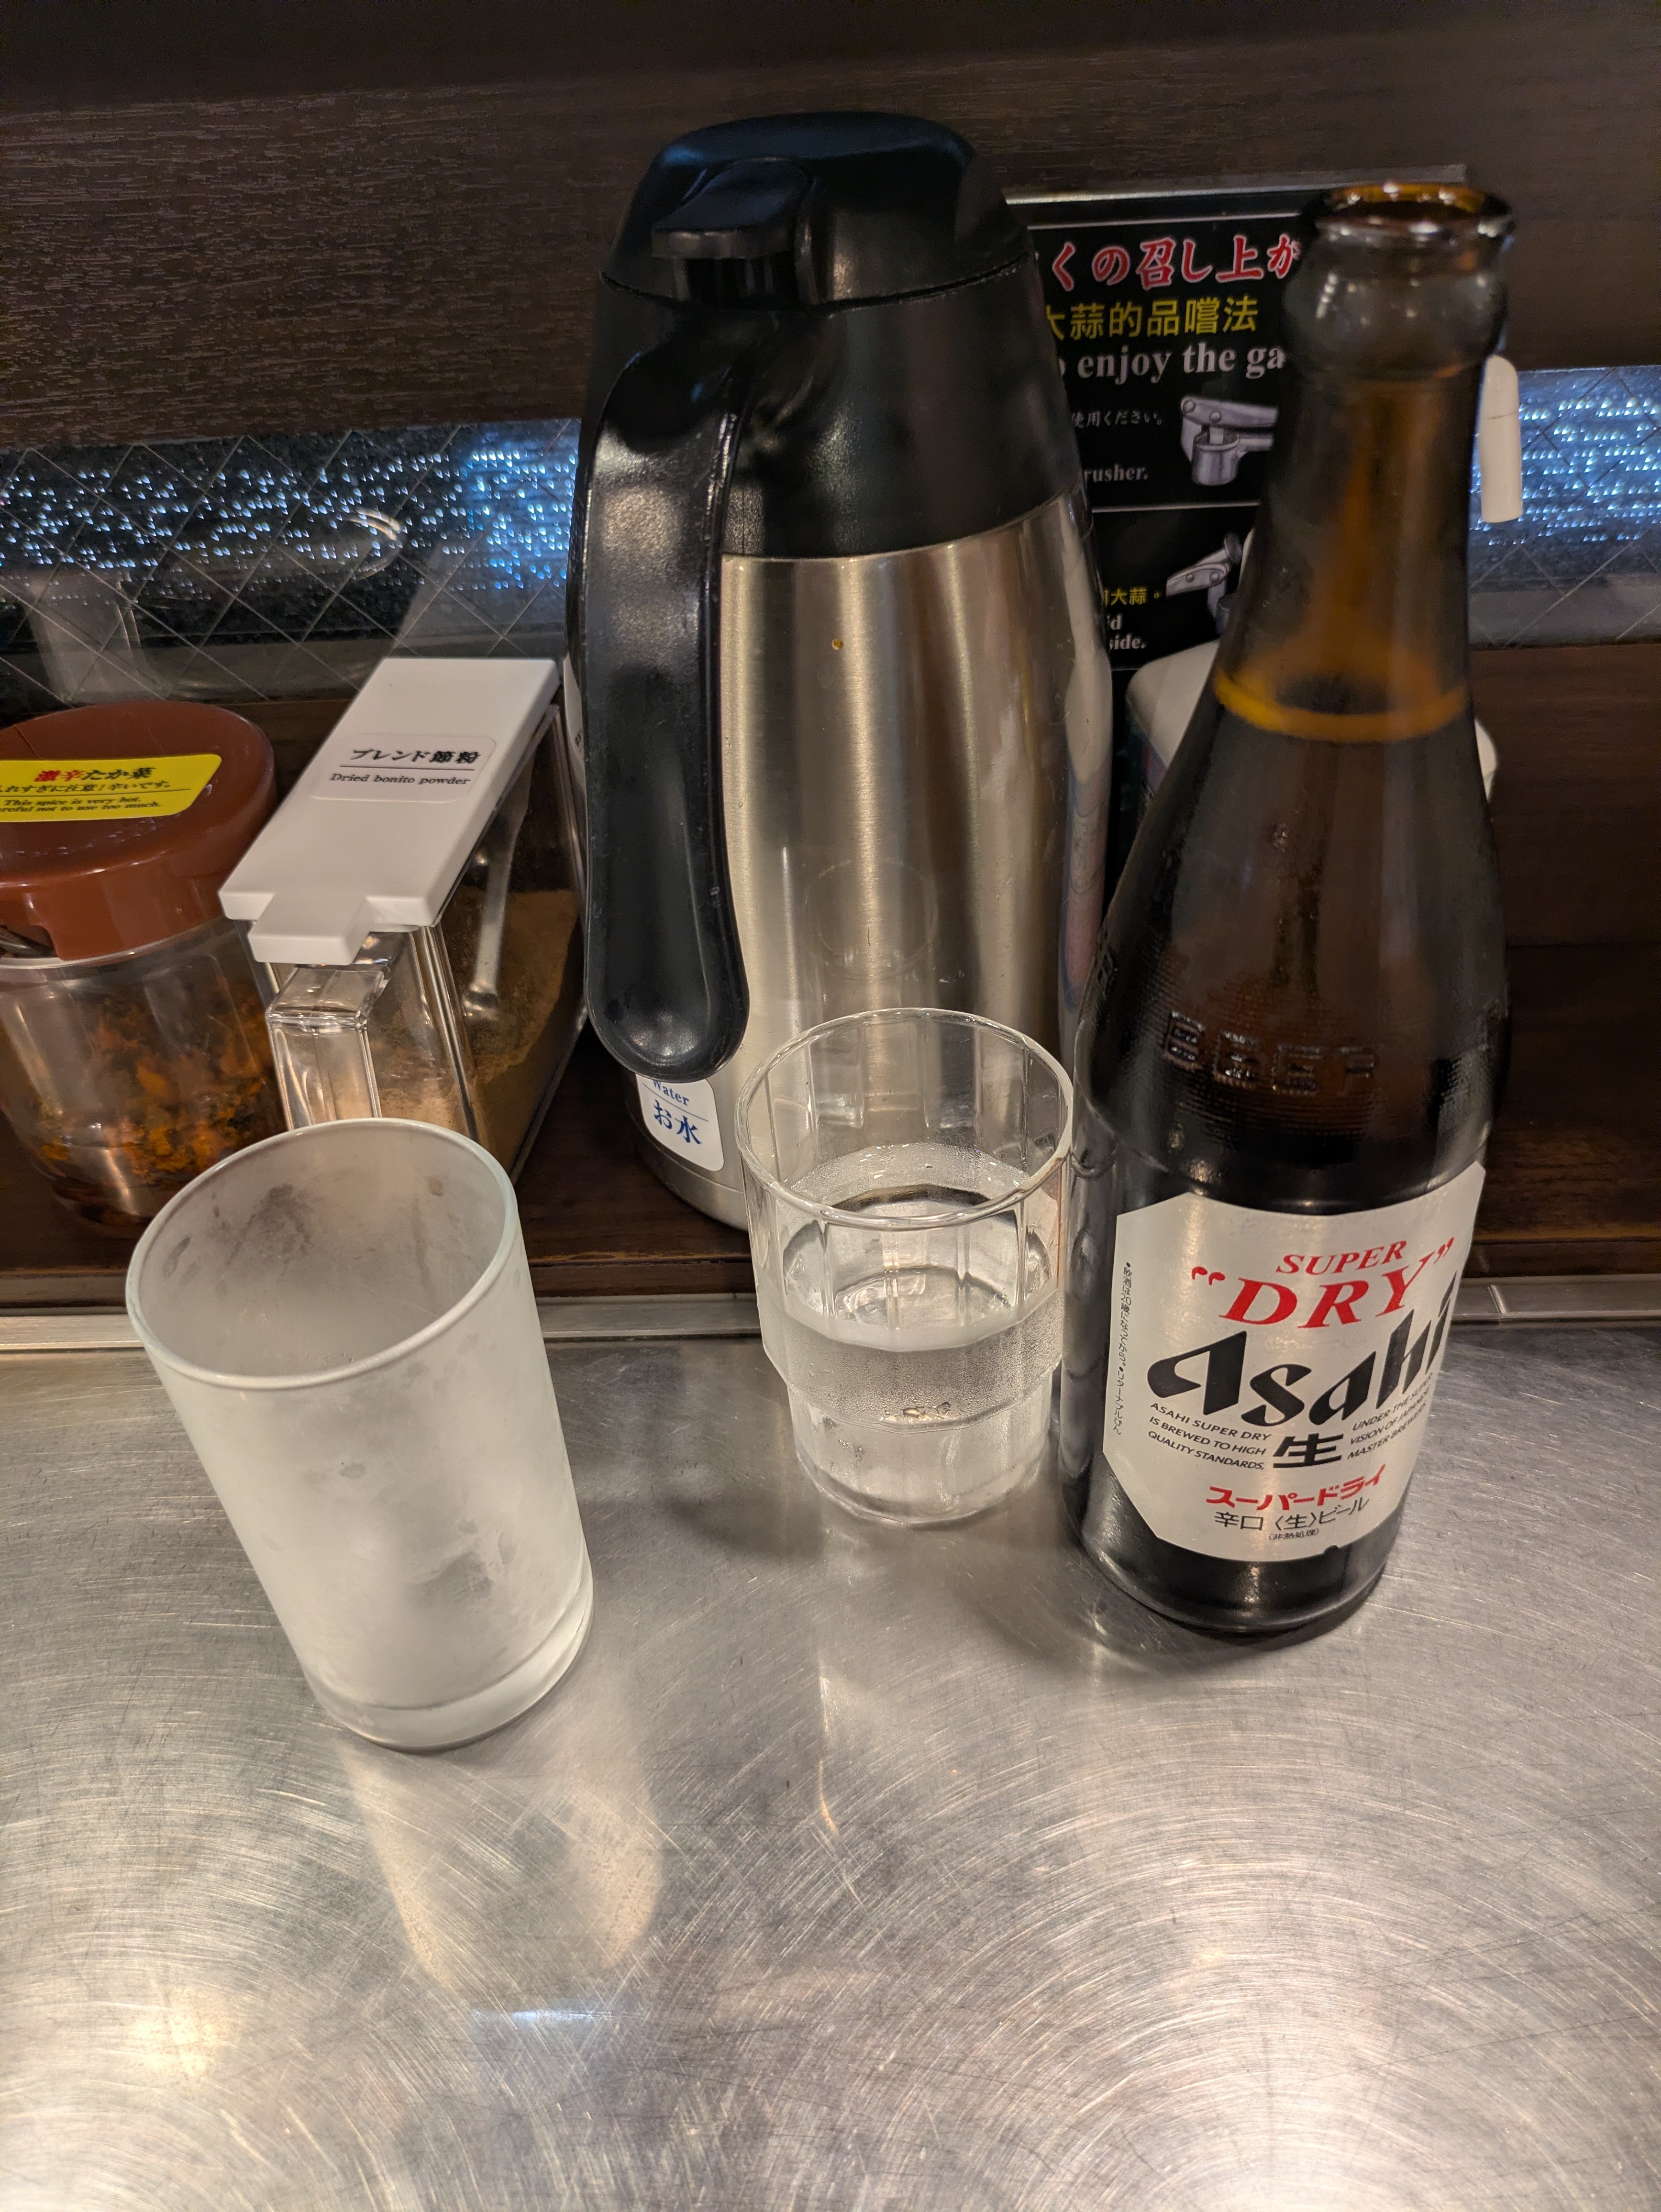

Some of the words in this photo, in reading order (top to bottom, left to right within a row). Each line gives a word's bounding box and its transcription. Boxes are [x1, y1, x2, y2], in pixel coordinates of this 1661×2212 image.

[1035, 233, 1302, 291] くの召し上が
[1077, 345, 1171, 385] enjoy
[1183, 342, 1235, 374] the
[1104, 587, 1160, 606] 大蒜。
[329, 773, 370, 783] Dried
[374, 774, 416, 784] bonito
[419, 775, 471, 785] powder
[652, 1079, 689, 1106] Water
[653, 1099, 702, 1145] お水
[1275, 1240, 1407, 1275] SUPER
[1147, 1270, 1458, 1427] Asahi
[1149, 1416, 1160, 1426] IS
[1161, 1422, 1211, 1445] BREWED
[1214, 1440, 1231, 1450] TO
[1232, 1444, 1267, 1458] HIGH
[1150, 1403, 1190, 1424] ASAHI
[1192, 1419, 1238, 1438] SUPER
[1240, 1431, 1272, 1441] DRY
[1350, 1425, 1384, 1445] VISION
[1384, 1416, 1398, 1430] OF
[1352, 1408, 1391, 1431] UNDER
[1148, 1430, 1196, 1454] QUALITY
[1272, 1432, 1344, 1469] 生
[1347, 1434, 1390, 1460] MASTER
[1205, 1463, 1386, 1511] スーパードライ
